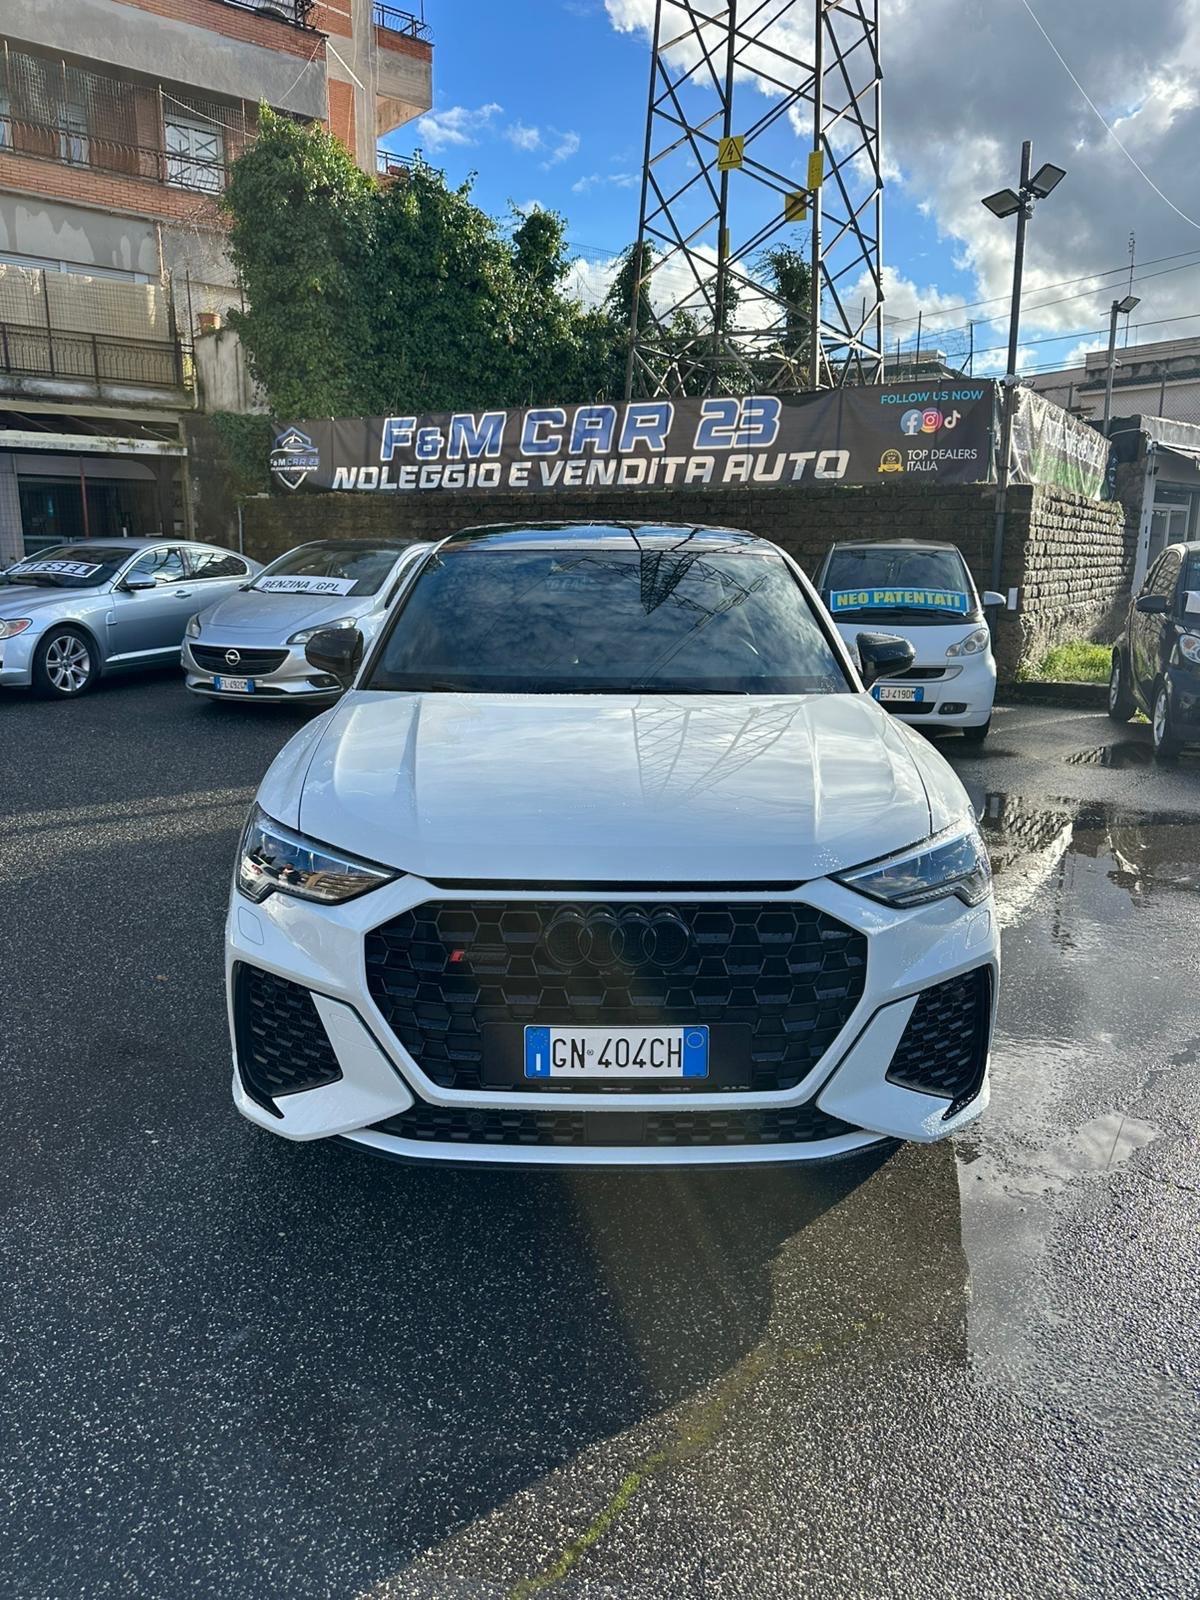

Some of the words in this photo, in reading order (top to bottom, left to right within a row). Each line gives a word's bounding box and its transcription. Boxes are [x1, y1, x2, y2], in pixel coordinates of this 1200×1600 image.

[880, 392, 930, 404] FOLLOW
[932, 391, 949, 401] US
[952, 390, 984, 401] NOW
[380, 411, 507, 461] F&M
[520, 401, 675, 456] CAR
[693, 396, 782, 450] 23
[907, 449, 929, 461] TOP
[931, 449, 978, 460] DEALERS
[332, 462, 502, 490] NOLEGGIO
[508, 461, 532, 487] E
[539, 456, 716, 487] VENDITA
[722, 449, 850, 483] AUTO
[906, 461, 938, 472] ITALIA
[11, 562, 92, 575] DIESEL
[261, 580, 311, 589] BENZINA
[837, 592, 869, 606] NEO
[873, 591, 961, 608] PATENTATI
[552, 1038, 586, 1069] GN
[597, 1038, 682, 1069] 404CH
